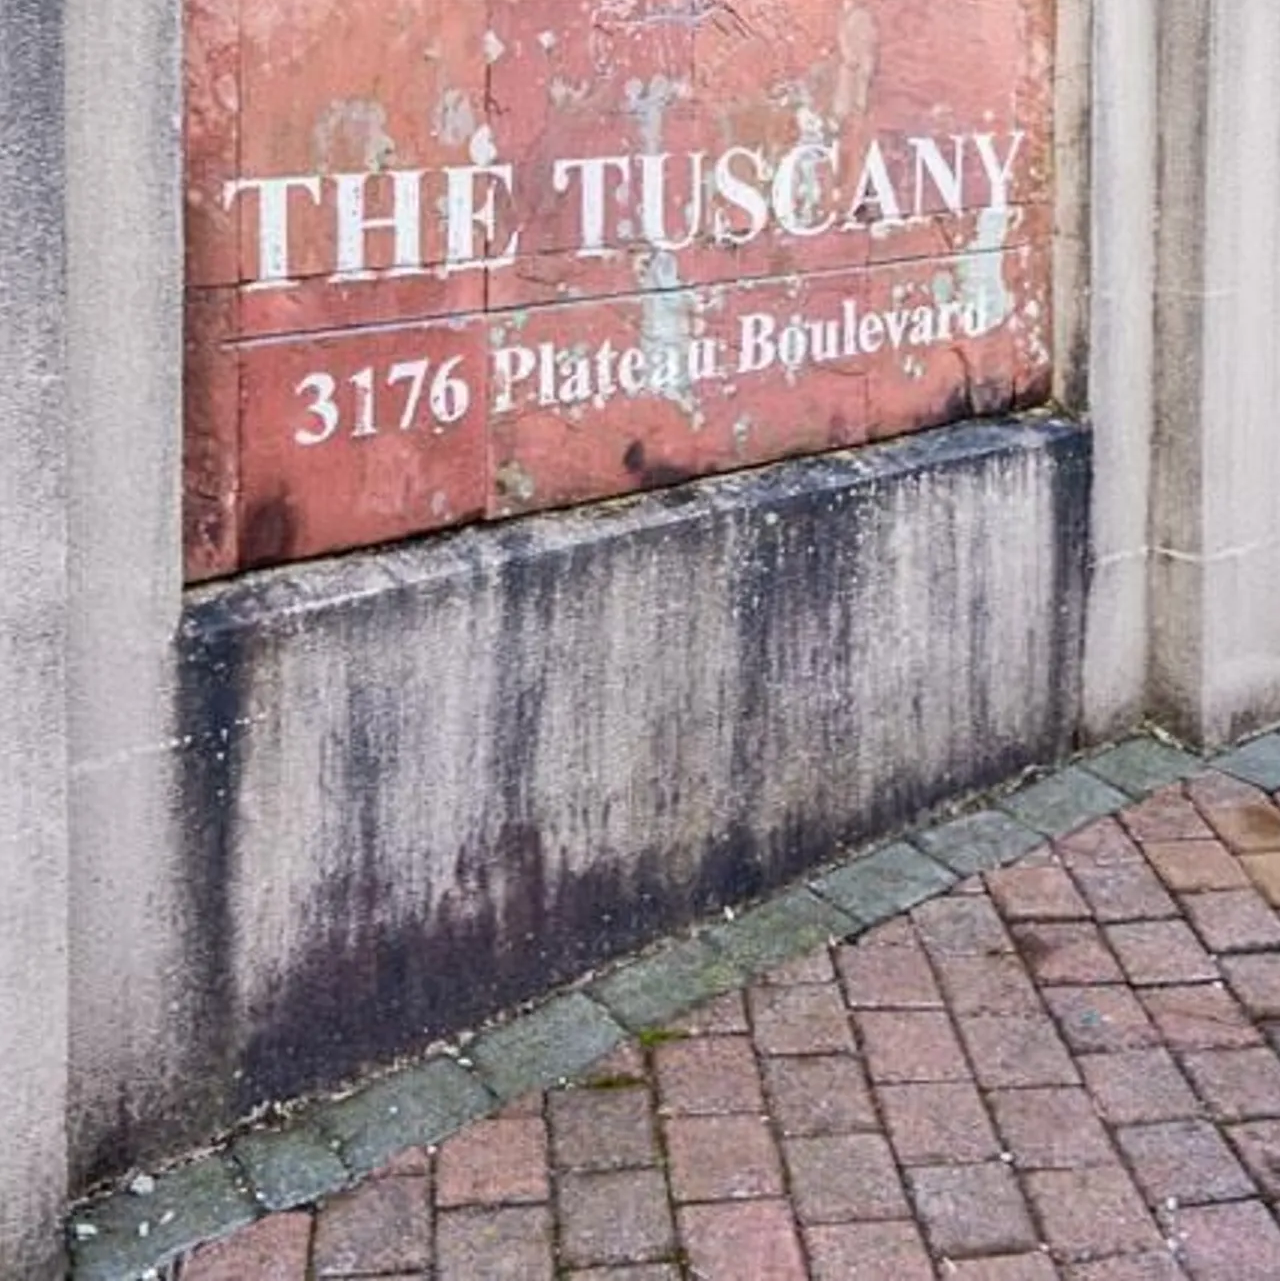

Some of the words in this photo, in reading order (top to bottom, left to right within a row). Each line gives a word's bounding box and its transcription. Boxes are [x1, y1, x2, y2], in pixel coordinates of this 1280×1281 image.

[222, 163, 521, 291] THE
[554, 130, 1025, 259] TUSCANY
[295, 356, 470, 446] 3176
[490, 338, 718, 415] Plateau
[735, 286, 993, 375] Boulevard
